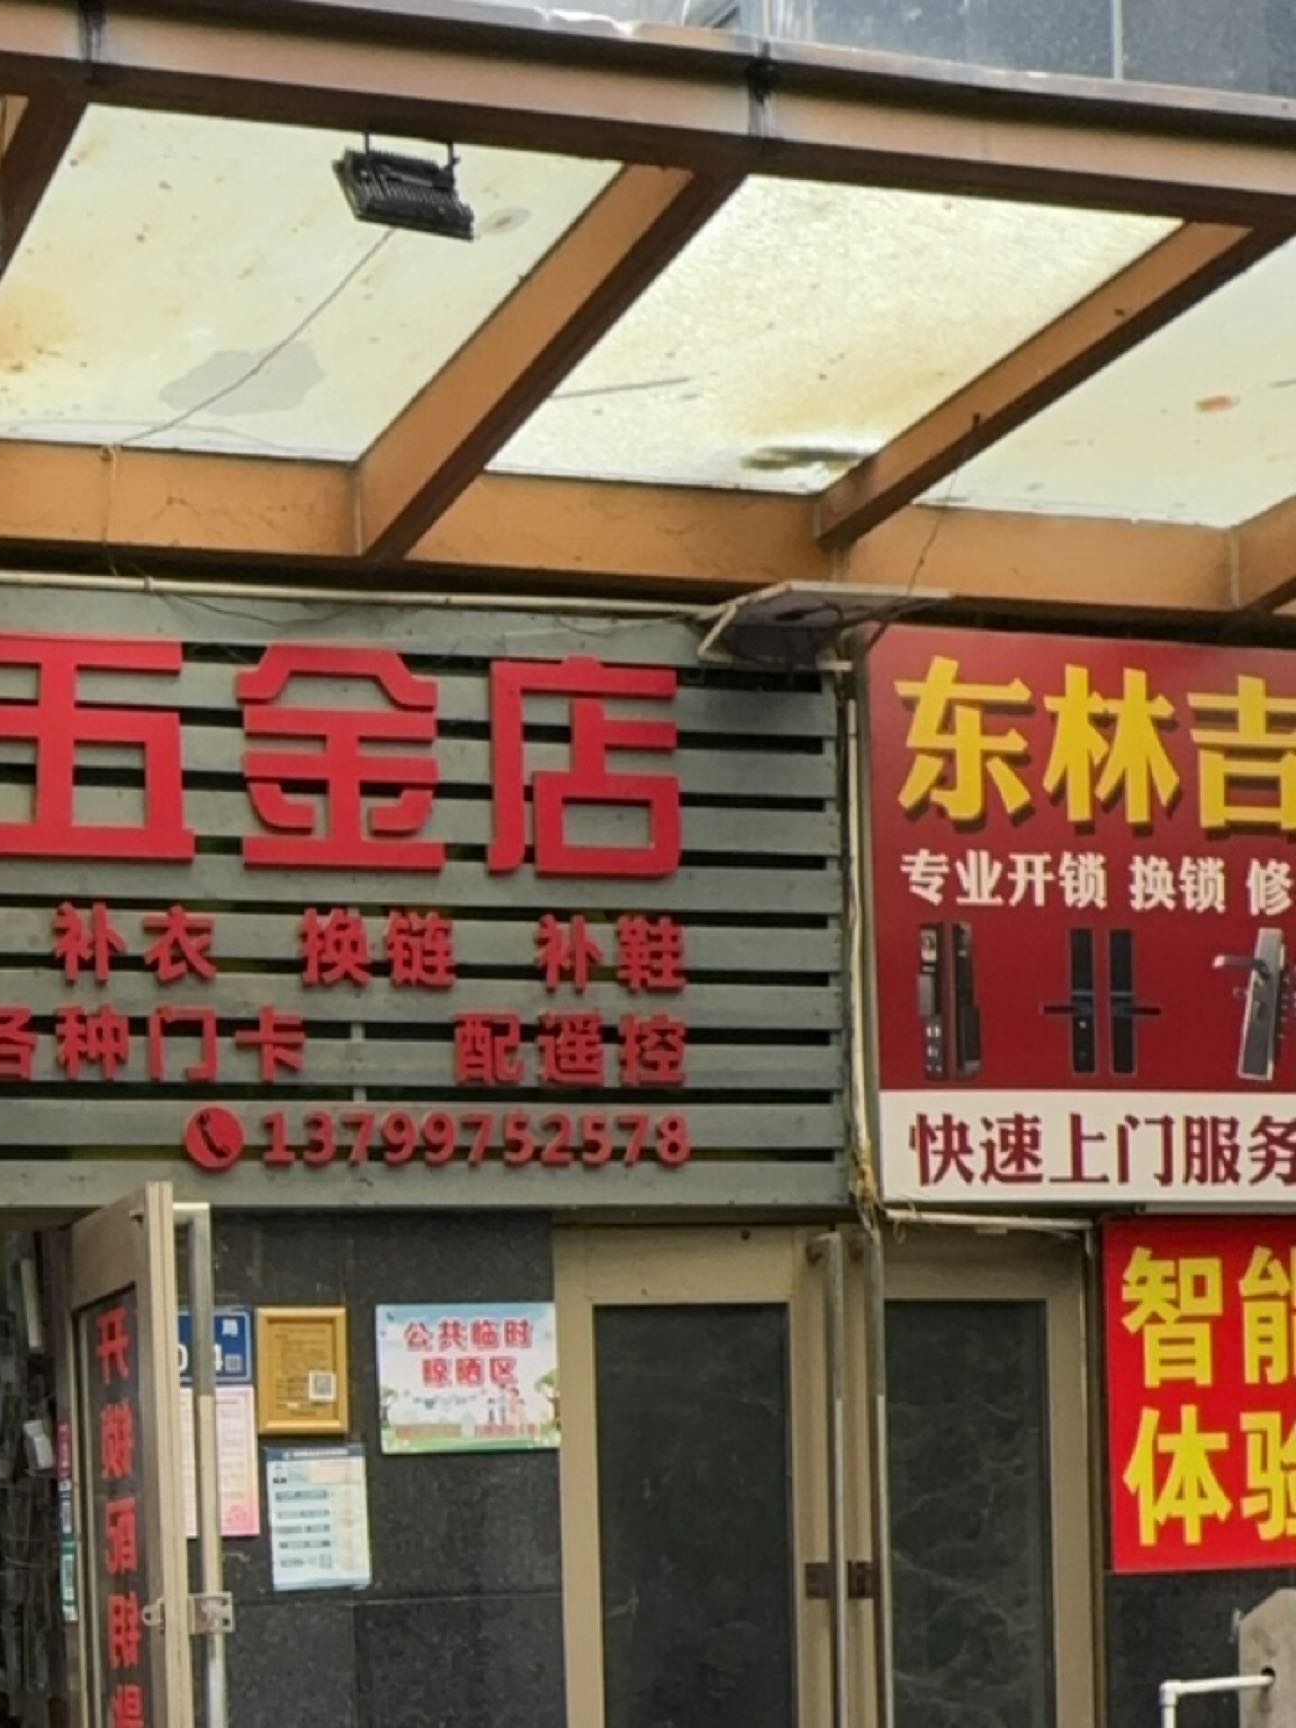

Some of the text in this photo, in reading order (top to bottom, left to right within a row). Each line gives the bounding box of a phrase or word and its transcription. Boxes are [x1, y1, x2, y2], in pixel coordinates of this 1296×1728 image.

[893, 656, 1296, 833] 东林吉
[900, 848, 1108, 910] 专业开锁
[1129, 854, 1228, 914] 换锁
[52, 900, 218, 985] 补衣
[299, 906, 456, 989] 换链
[534, 912, 686, 994] 补鞋
[454, 1007, 686, 1088] 配遥控
[261, 1109, 693, 1172] 13799752578
[908, 1111, 1296, 1188] 快速上门服务
[403, 1318, 533, 1352] 公共临时
